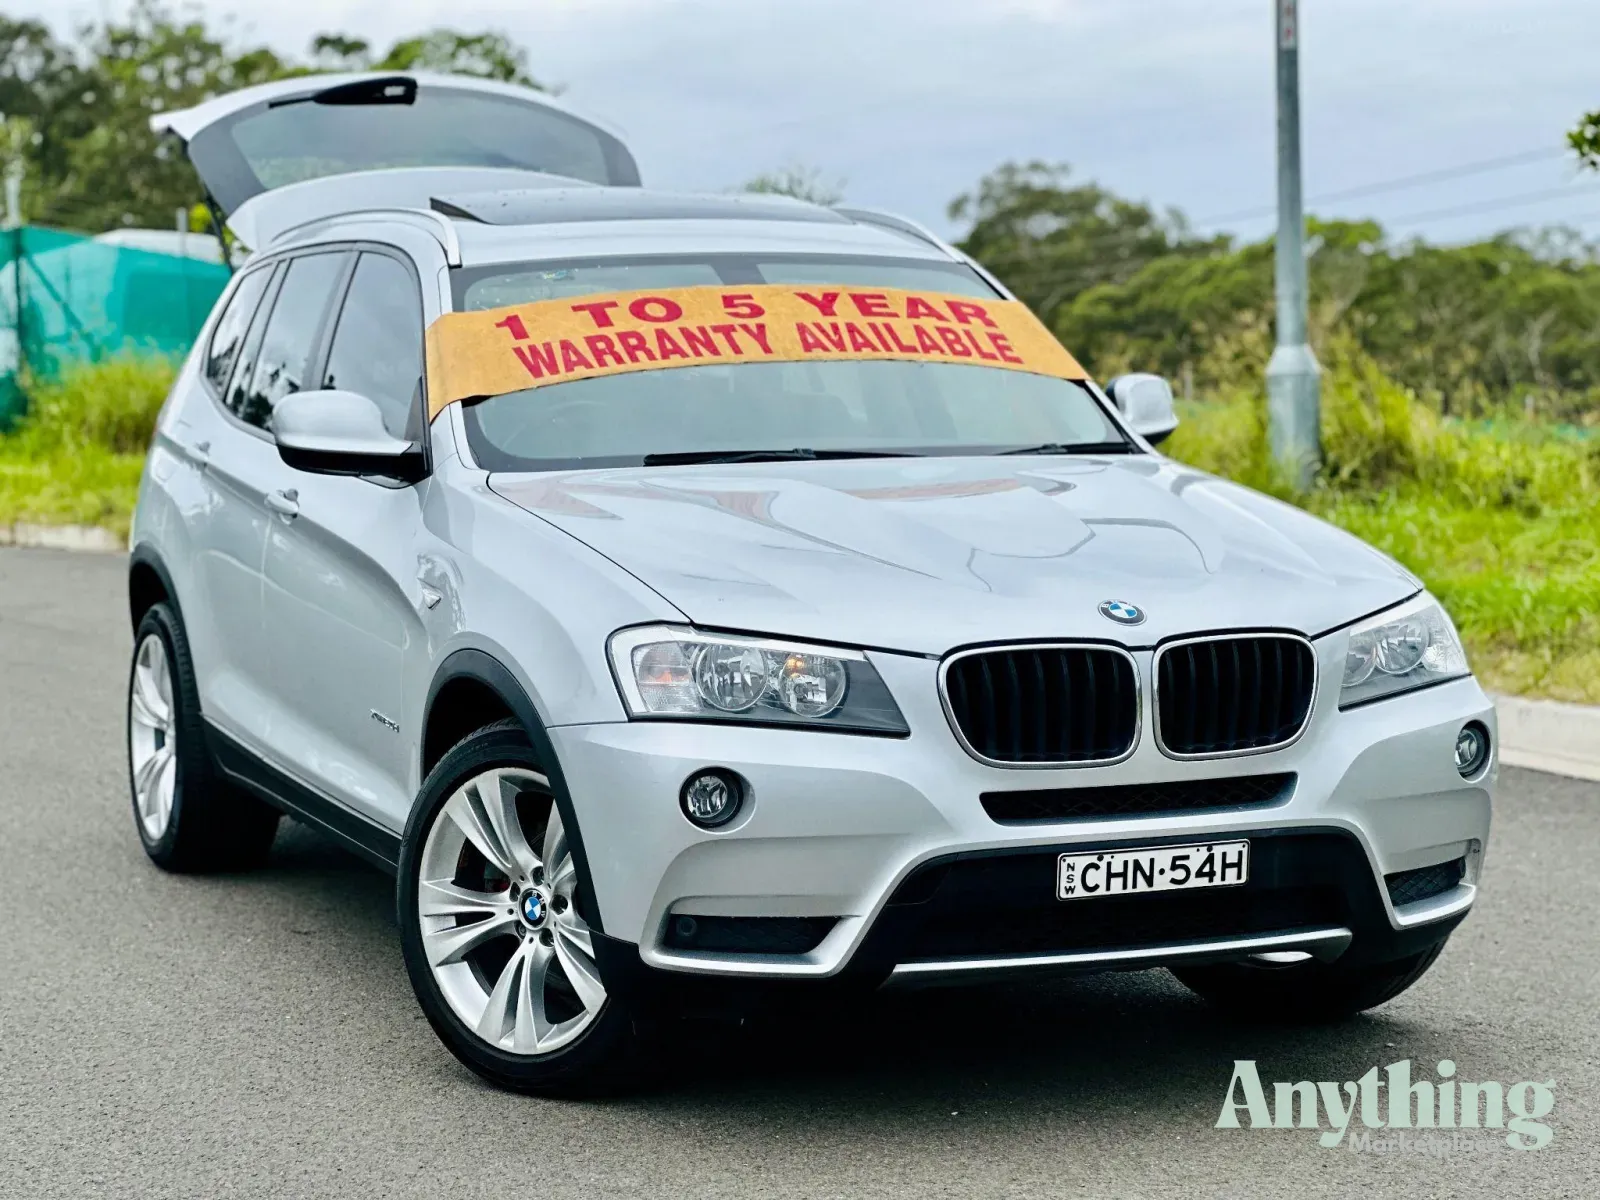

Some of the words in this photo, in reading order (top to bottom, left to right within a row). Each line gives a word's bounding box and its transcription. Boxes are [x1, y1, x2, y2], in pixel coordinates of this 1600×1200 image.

[495, 314, 530, 341] 1
[570, 297, 684, 329] TO
[721, 294, 766, 319] 5
[795, 292, 998, 328] YEAR
[512, 323, 774, 379] WARRANTY
[795, 322, 1022, 364] AVAILABLE
[1065, 862, 1076, 895] NSW
